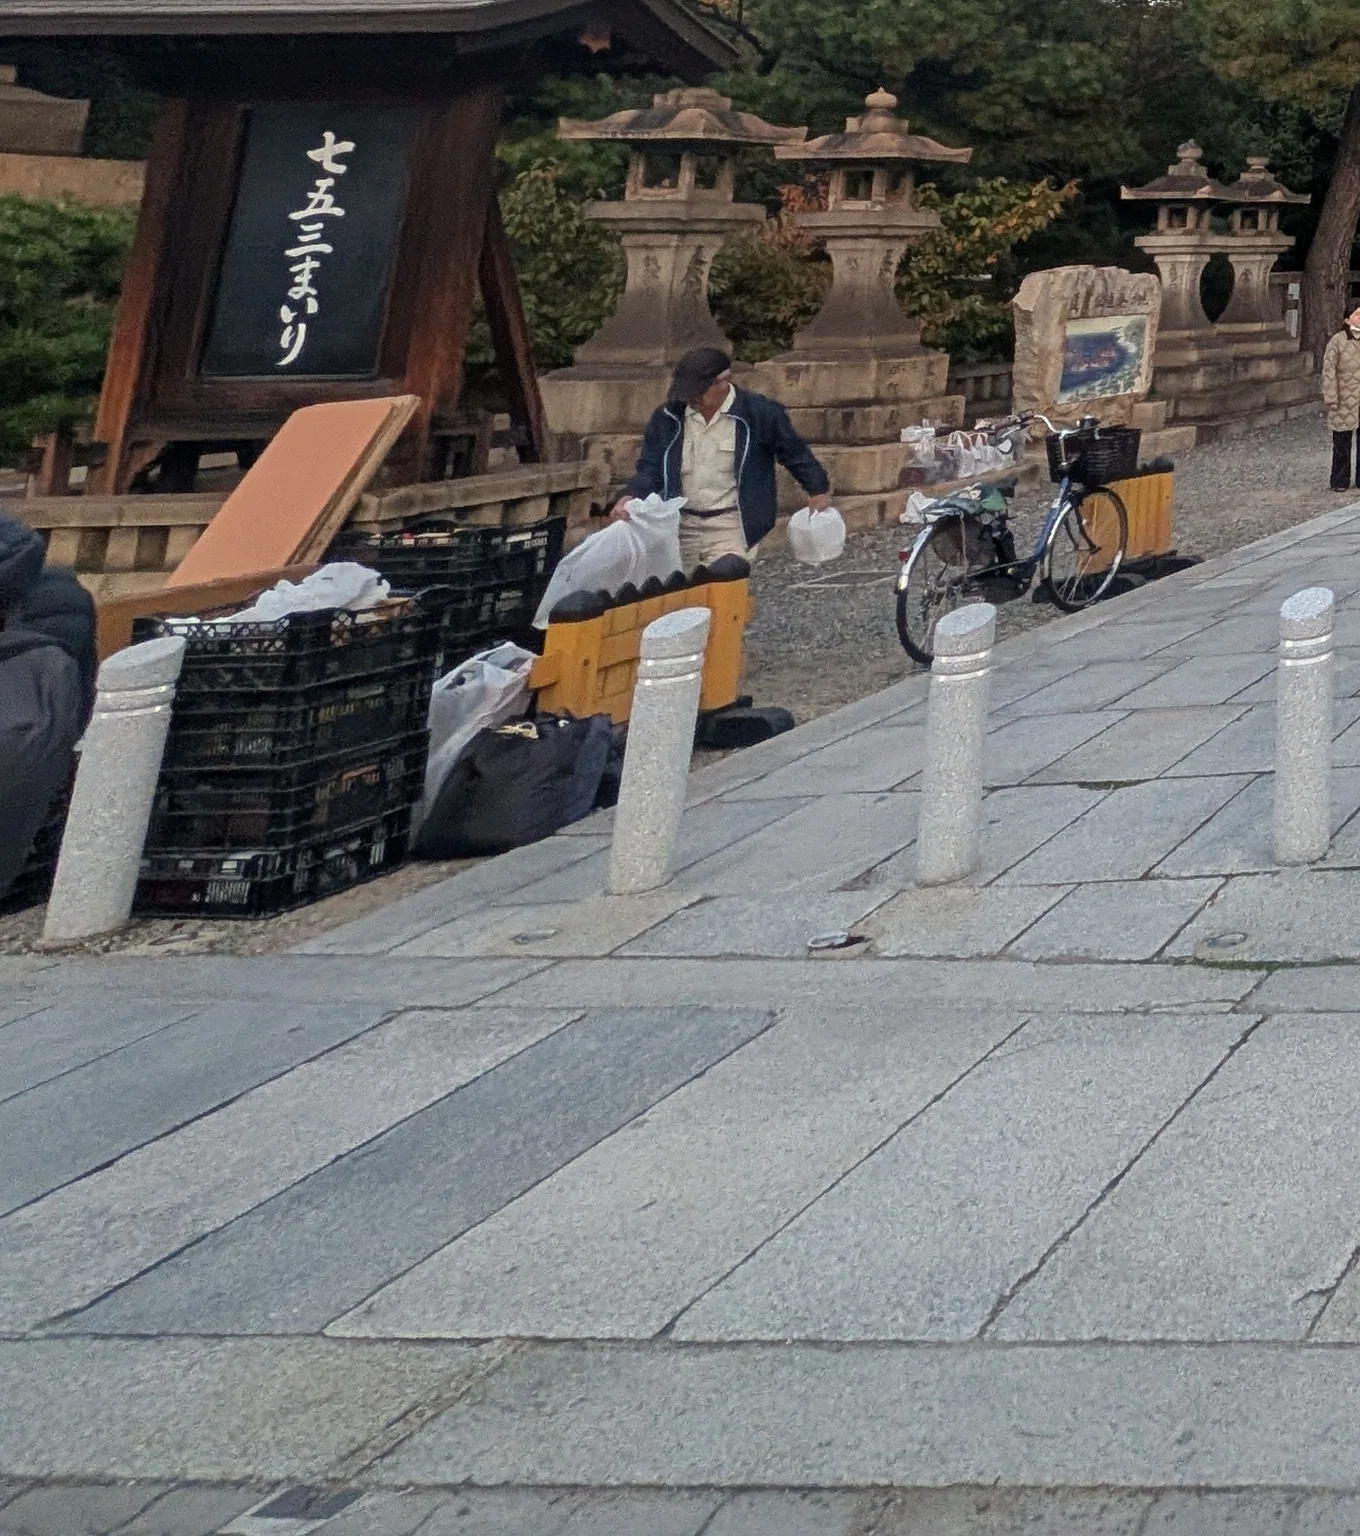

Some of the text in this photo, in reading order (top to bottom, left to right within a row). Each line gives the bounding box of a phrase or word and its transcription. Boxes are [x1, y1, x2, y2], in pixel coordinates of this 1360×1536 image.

[275, 130, 356, 366] 七五三まいり
